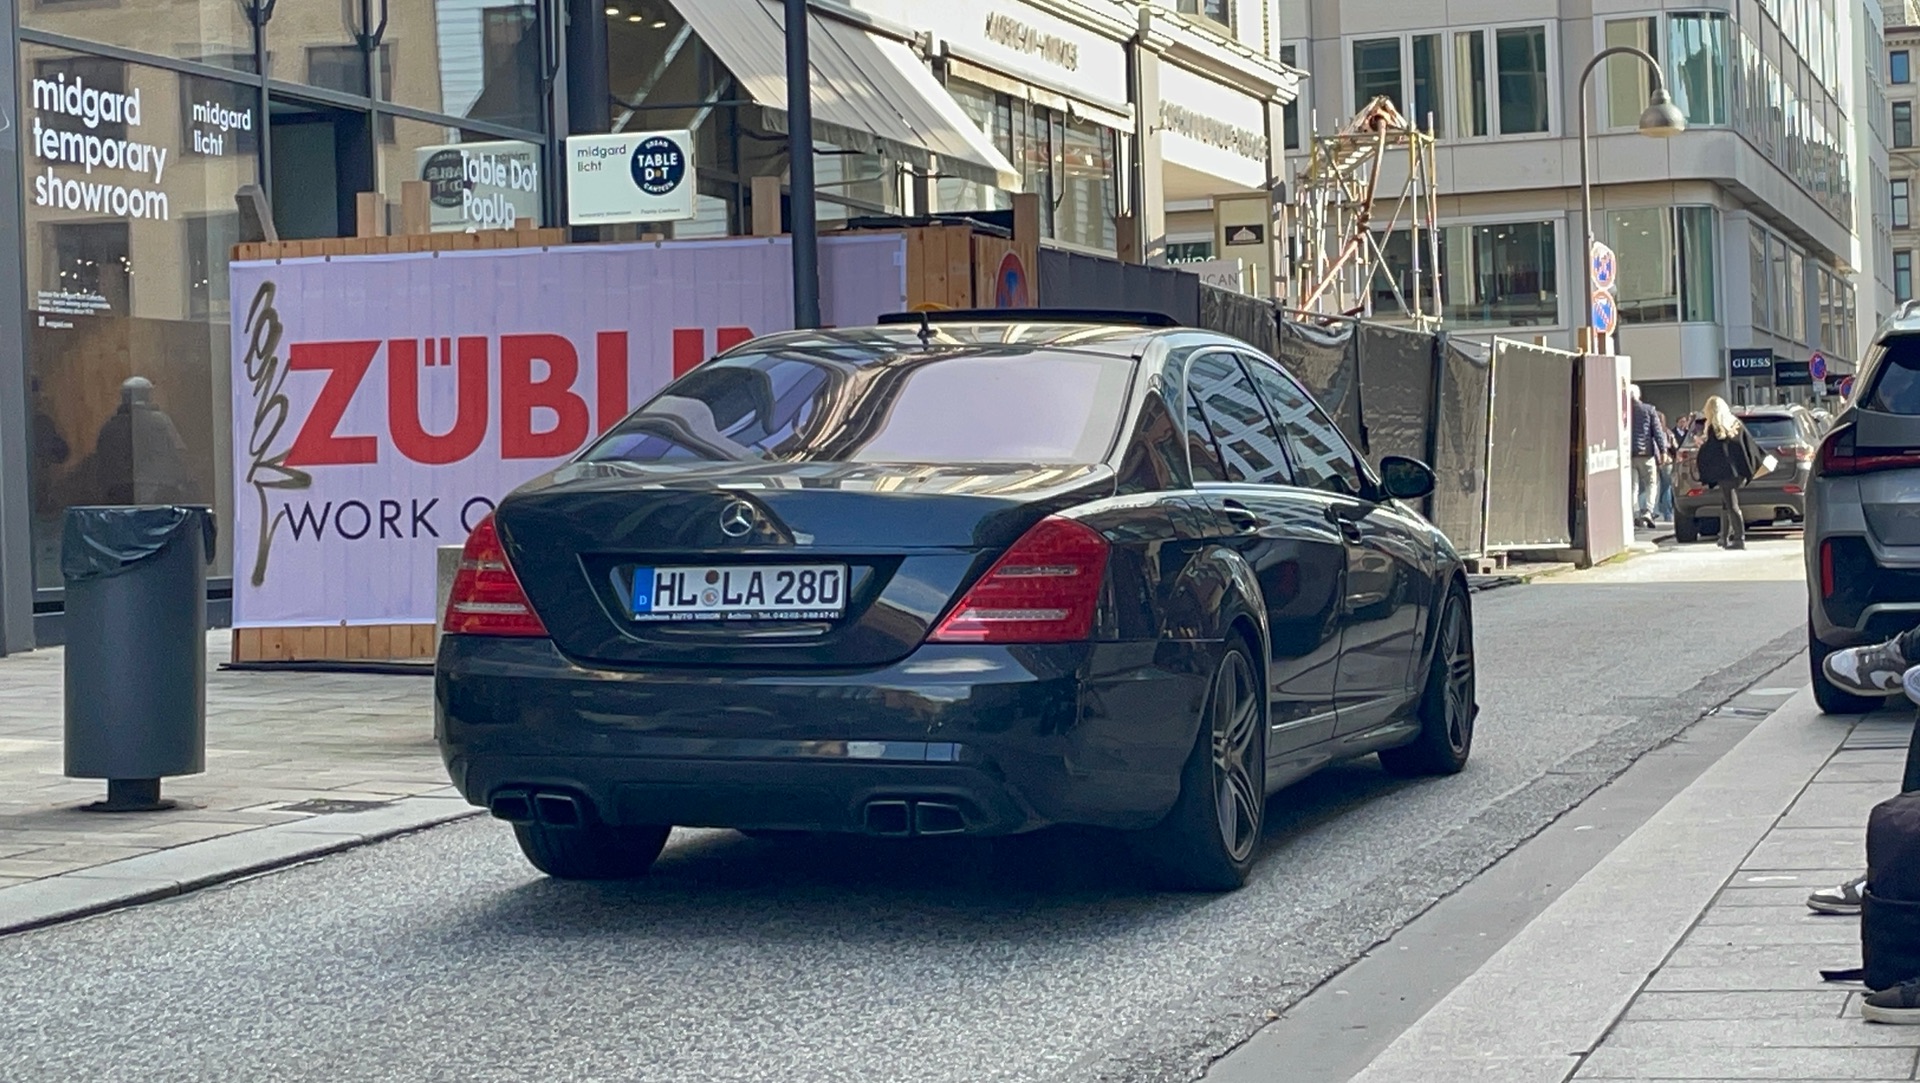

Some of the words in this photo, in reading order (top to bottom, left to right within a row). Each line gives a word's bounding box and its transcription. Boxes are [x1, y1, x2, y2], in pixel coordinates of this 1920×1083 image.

[33, 72, 141, 128] midgard
[193, 101, 251, 132] midgard
[33, 117, 167, 184] temporary
[194, 130, 223, 156] licht
[577, 144, 627, 158] midgard
[638, 153, 678, 168] TABLE
[461, 150, 506, 187] Table
[511, 159, 538, 192] Dot
[577, 161, 602, 172] licht
[35, 167, 169, 220] showroom
[463, 188, 515, 231] PopUp
[1732, 357, 1771, 368] GUESS
[283, 324, 836, 467] ZÜBL
[284, 498, 439, 542] WORK
[638, 595, 648, 605] D
[654, 572, 698, 606] HL
[722, 571, 766, 605] LA
[774, 570, 840, 605] 280
